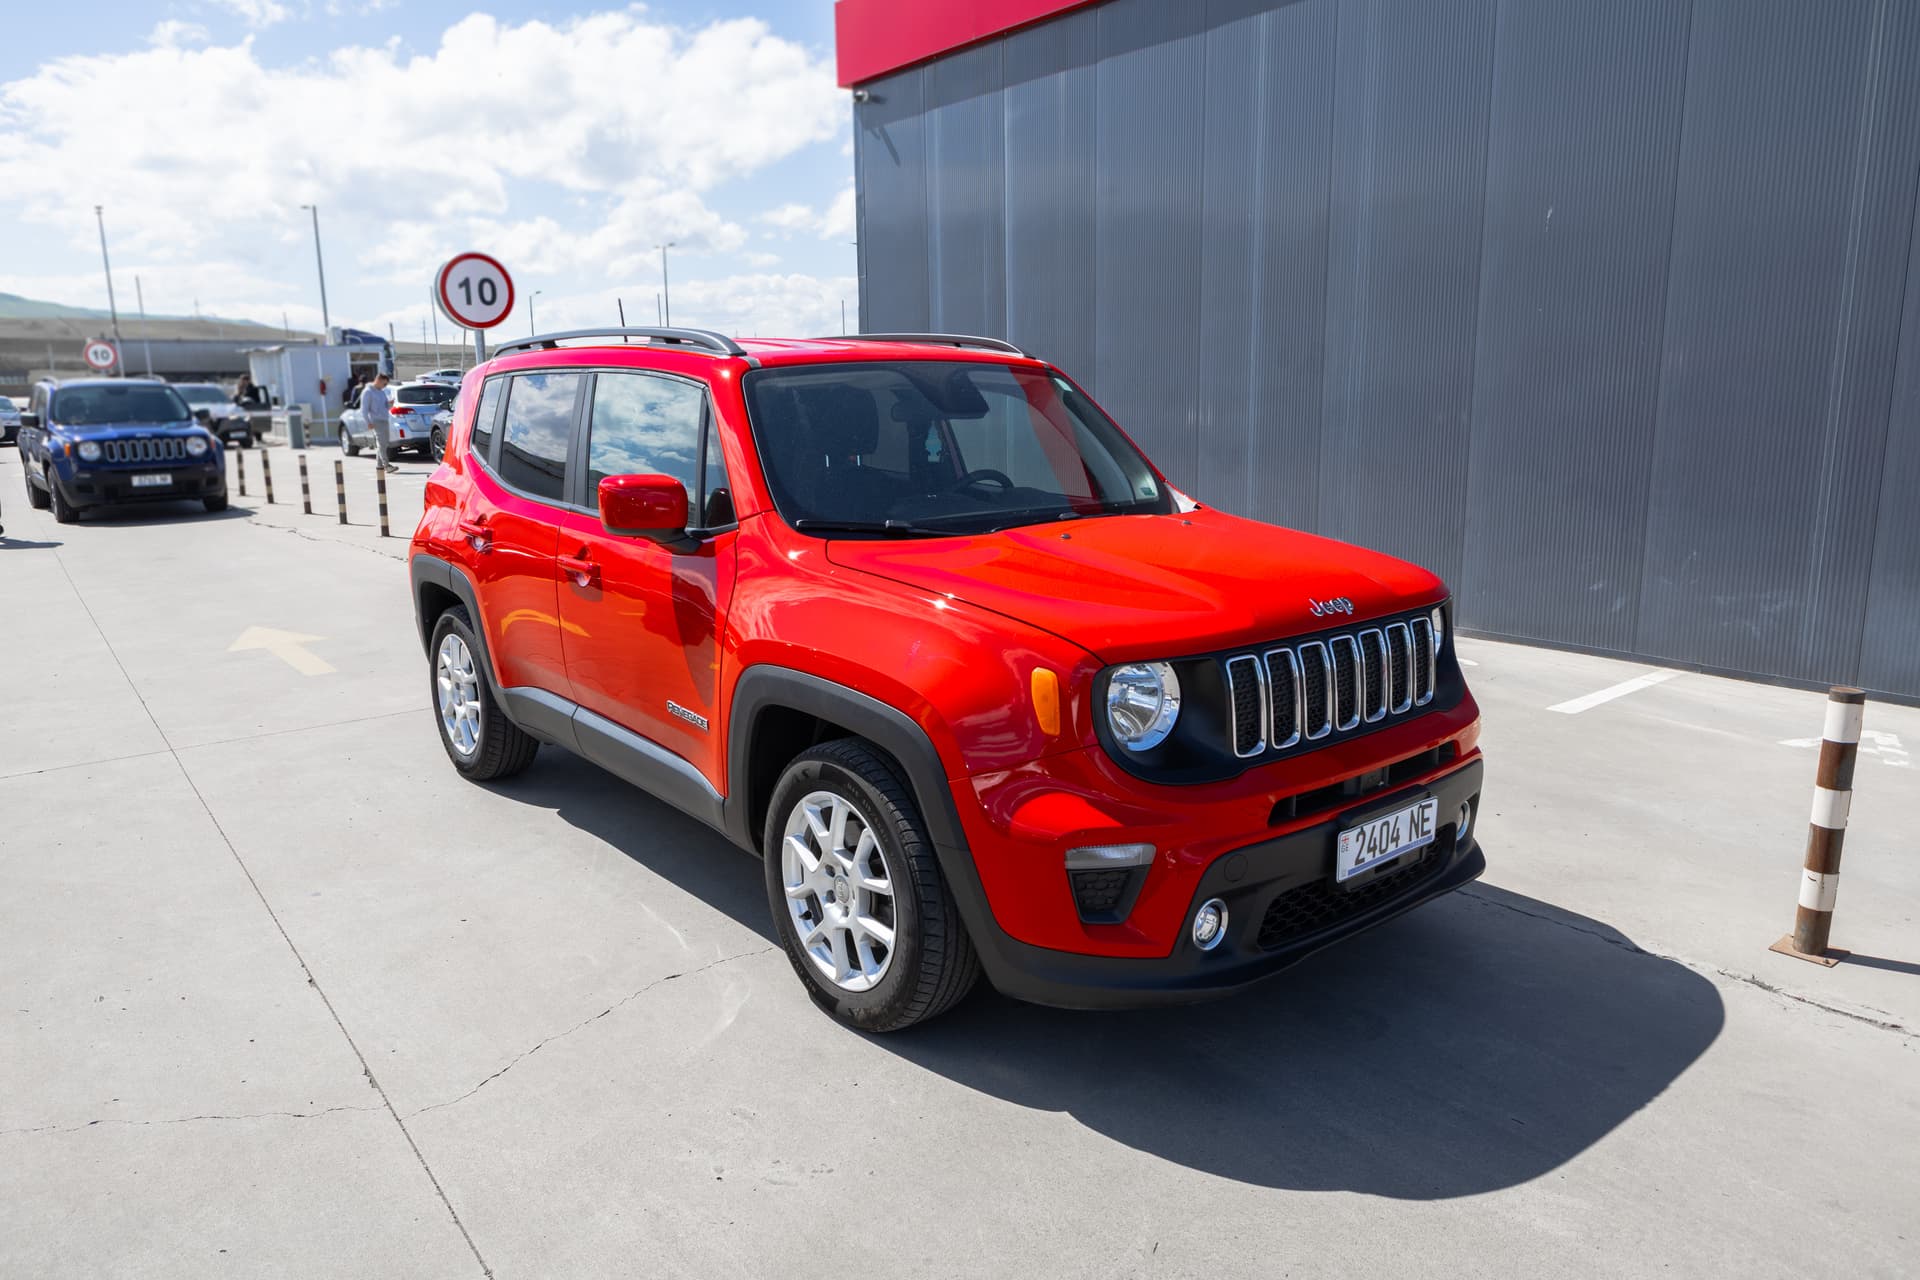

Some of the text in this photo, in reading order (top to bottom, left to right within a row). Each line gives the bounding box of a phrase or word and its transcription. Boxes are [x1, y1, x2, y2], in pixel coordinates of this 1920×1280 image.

[458, 276, 497, 306] 10
[92, 349, 110, 361] 10
[1309, 597, 1353, 616] Jeep
[1354, 803, 1433, 866] 2404 NE
